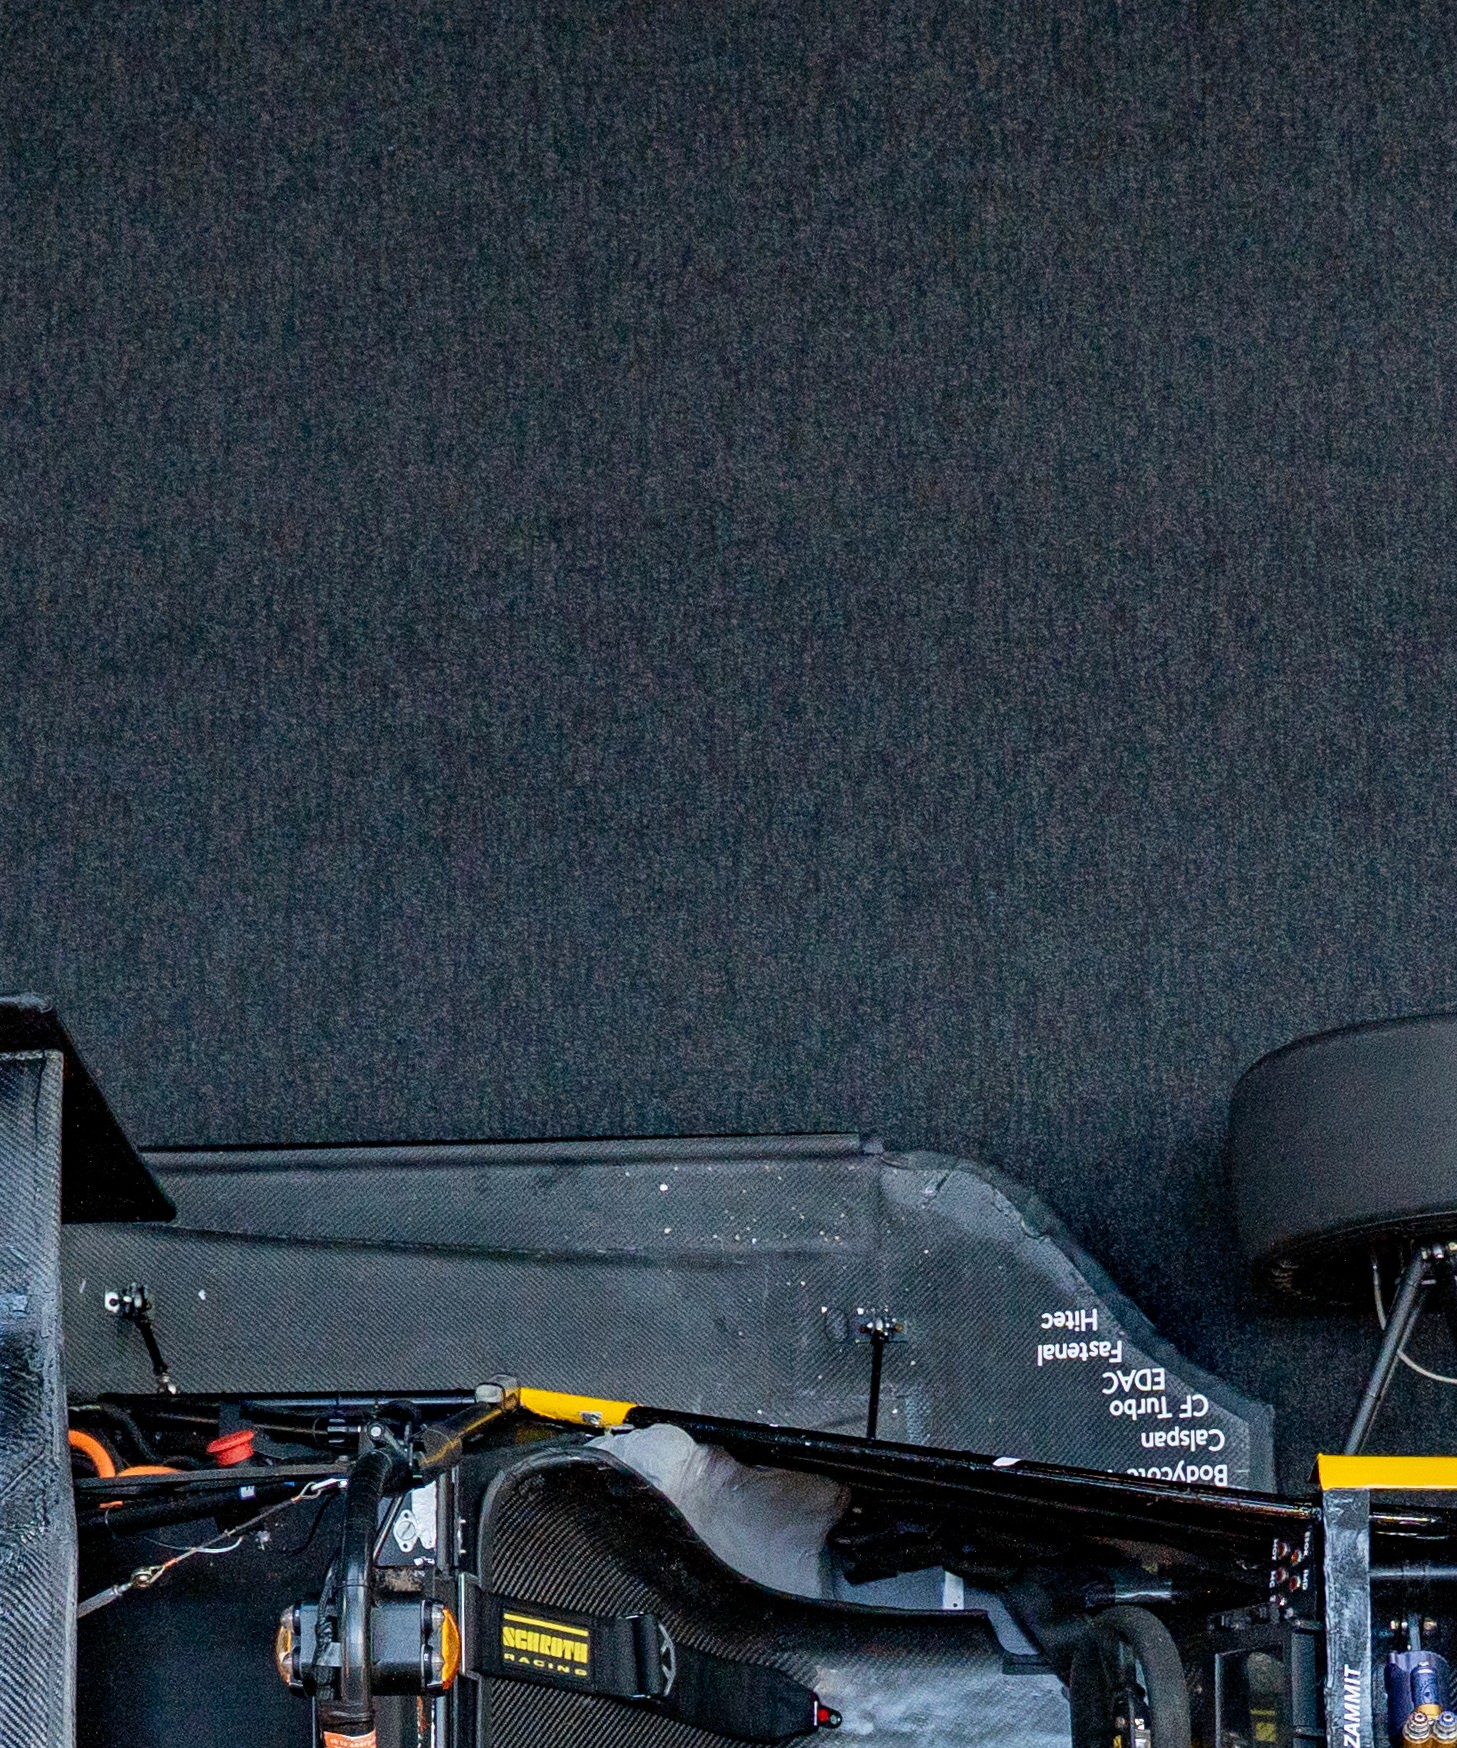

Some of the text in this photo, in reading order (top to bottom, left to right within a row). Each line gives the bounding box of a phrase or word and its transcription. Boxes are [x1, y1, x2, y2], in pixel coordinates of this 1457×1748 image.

[1040, 1308, 1098, 1332] Hitec
[1037, 1340, 1122, 1366] Fastenal
[1101, 1367, 1166, 1394] EDAC
[1109, 1393, 1209, 1420] CF Turbo
[1141, 1427, 1225, 1452] Calspan
[502, 1626, 589, 1664] SCHROTH
[503, 1653, 588, 1676] RACING
